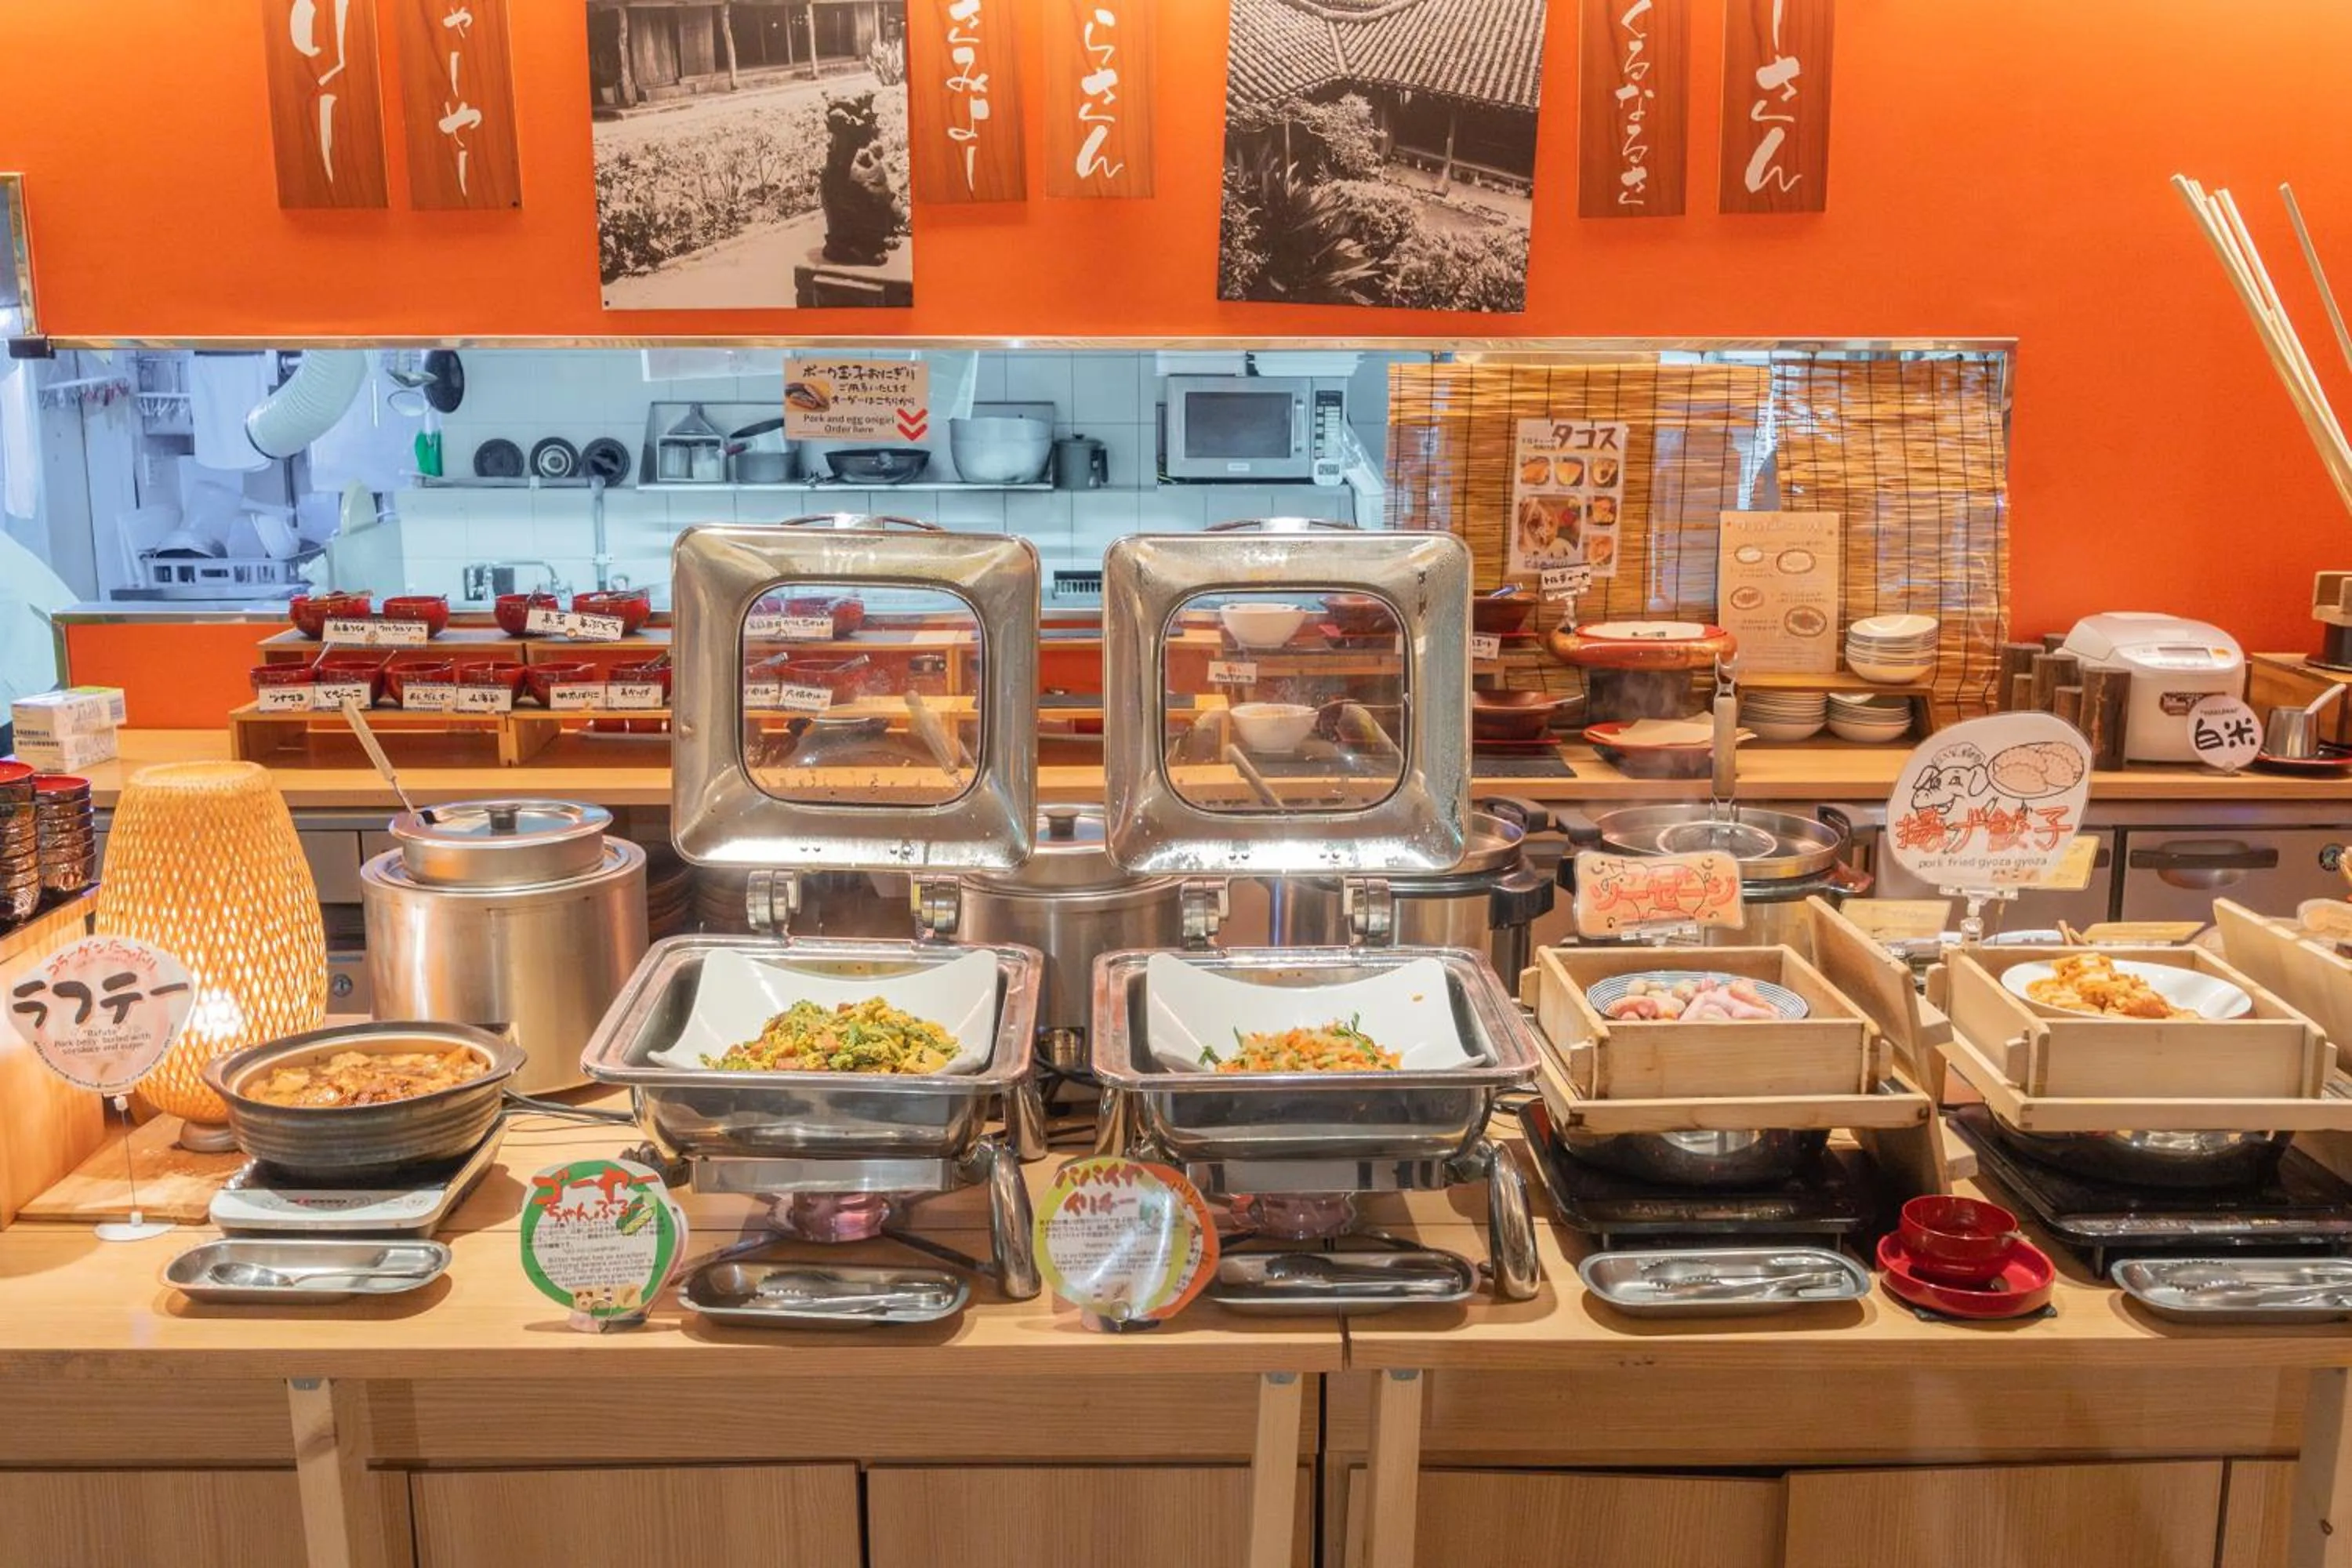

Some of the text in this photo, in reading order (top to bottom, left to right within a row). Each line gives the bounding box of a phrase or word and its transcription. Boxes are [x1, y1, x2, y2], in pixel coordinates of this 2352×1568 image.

[804, 413, 895, 425] Pork and egg onigiri
[824, 424, 875, 433] Order here
[1552, 424, 1618, 451] タコス
[2194, 717, 2255, 750] 白米
[1918, 857, 2048, 869] pork fried gyoza gyoza
[13, 971, 189, 1029] ラフテー
[532, 1166, 660, 1205] ゴーヤー
